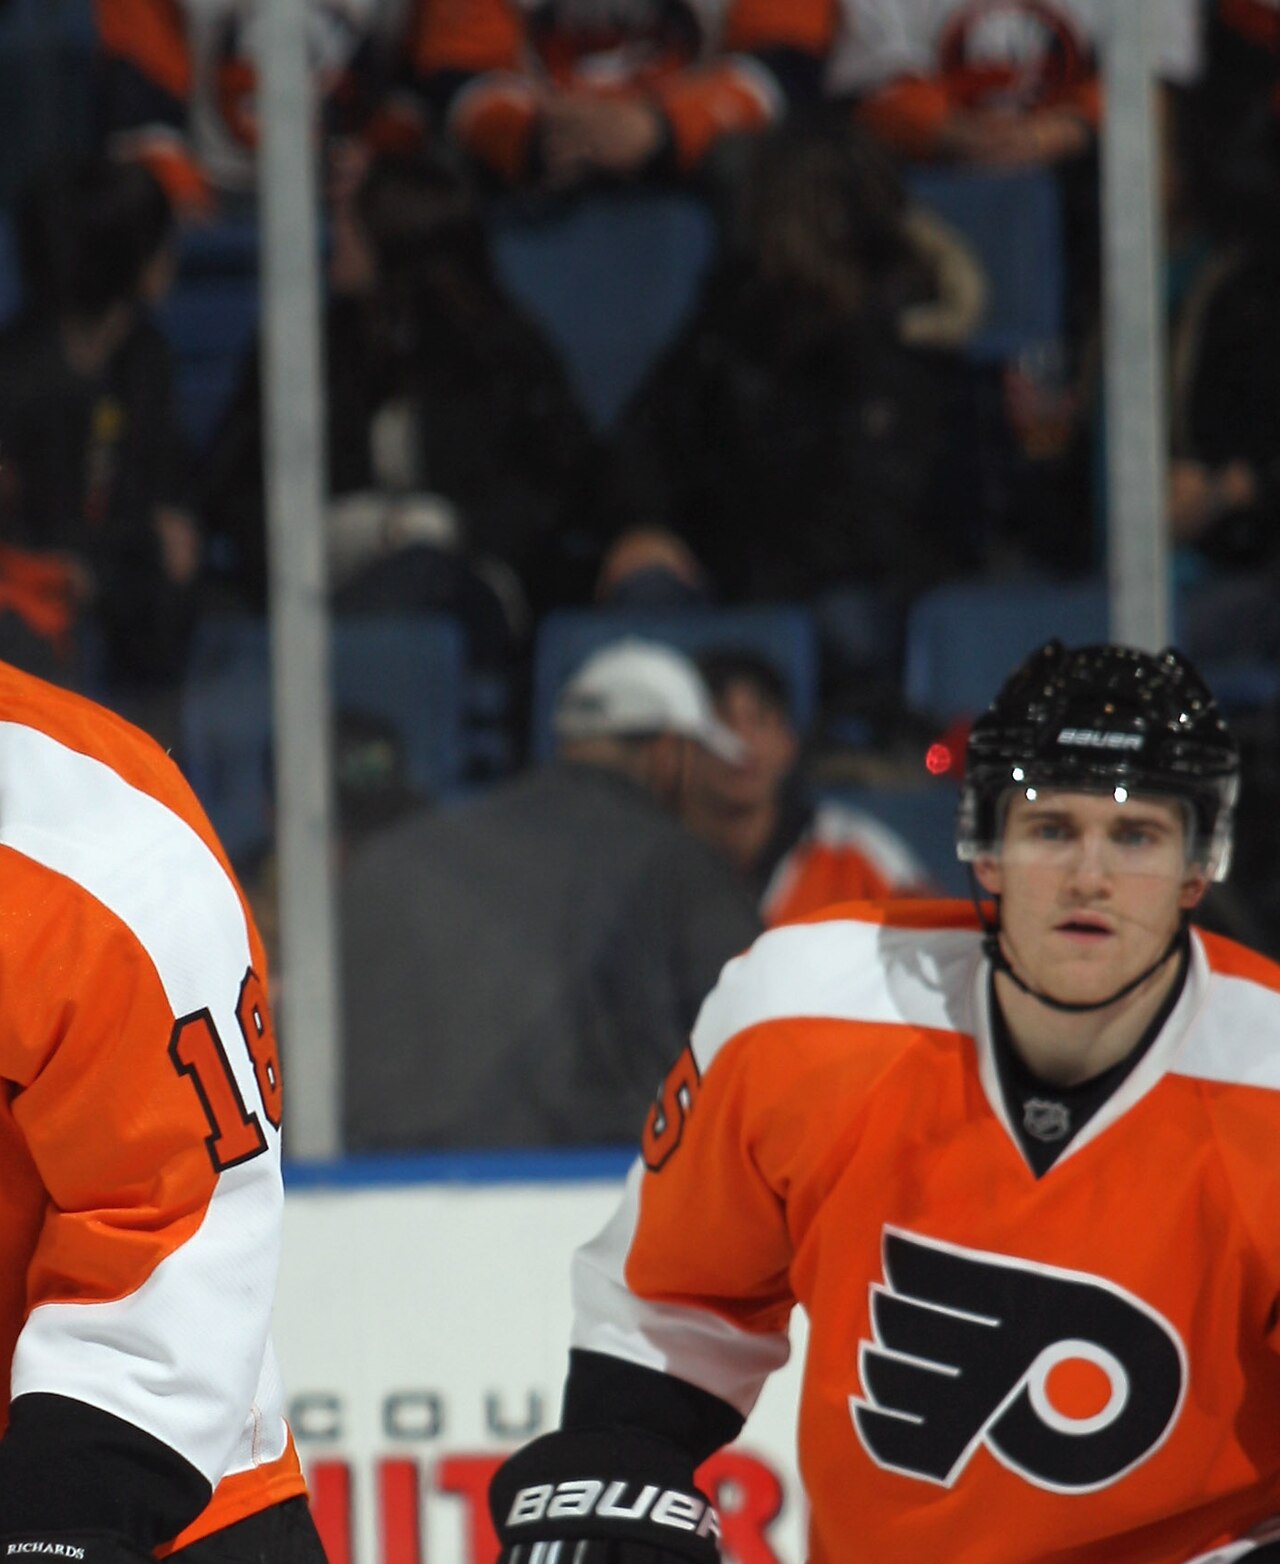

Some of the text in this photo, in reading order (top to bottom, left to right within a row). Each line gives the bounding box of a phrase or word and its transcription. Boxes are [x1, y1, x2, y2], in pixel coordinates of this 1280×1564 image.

[1056, 727, 1144, 751] BAUER
[167, 965, 284, 1174] 18
[288, 1390, 544, 1443] COU
[6, 1541, 85, 1560] RICHARDS
